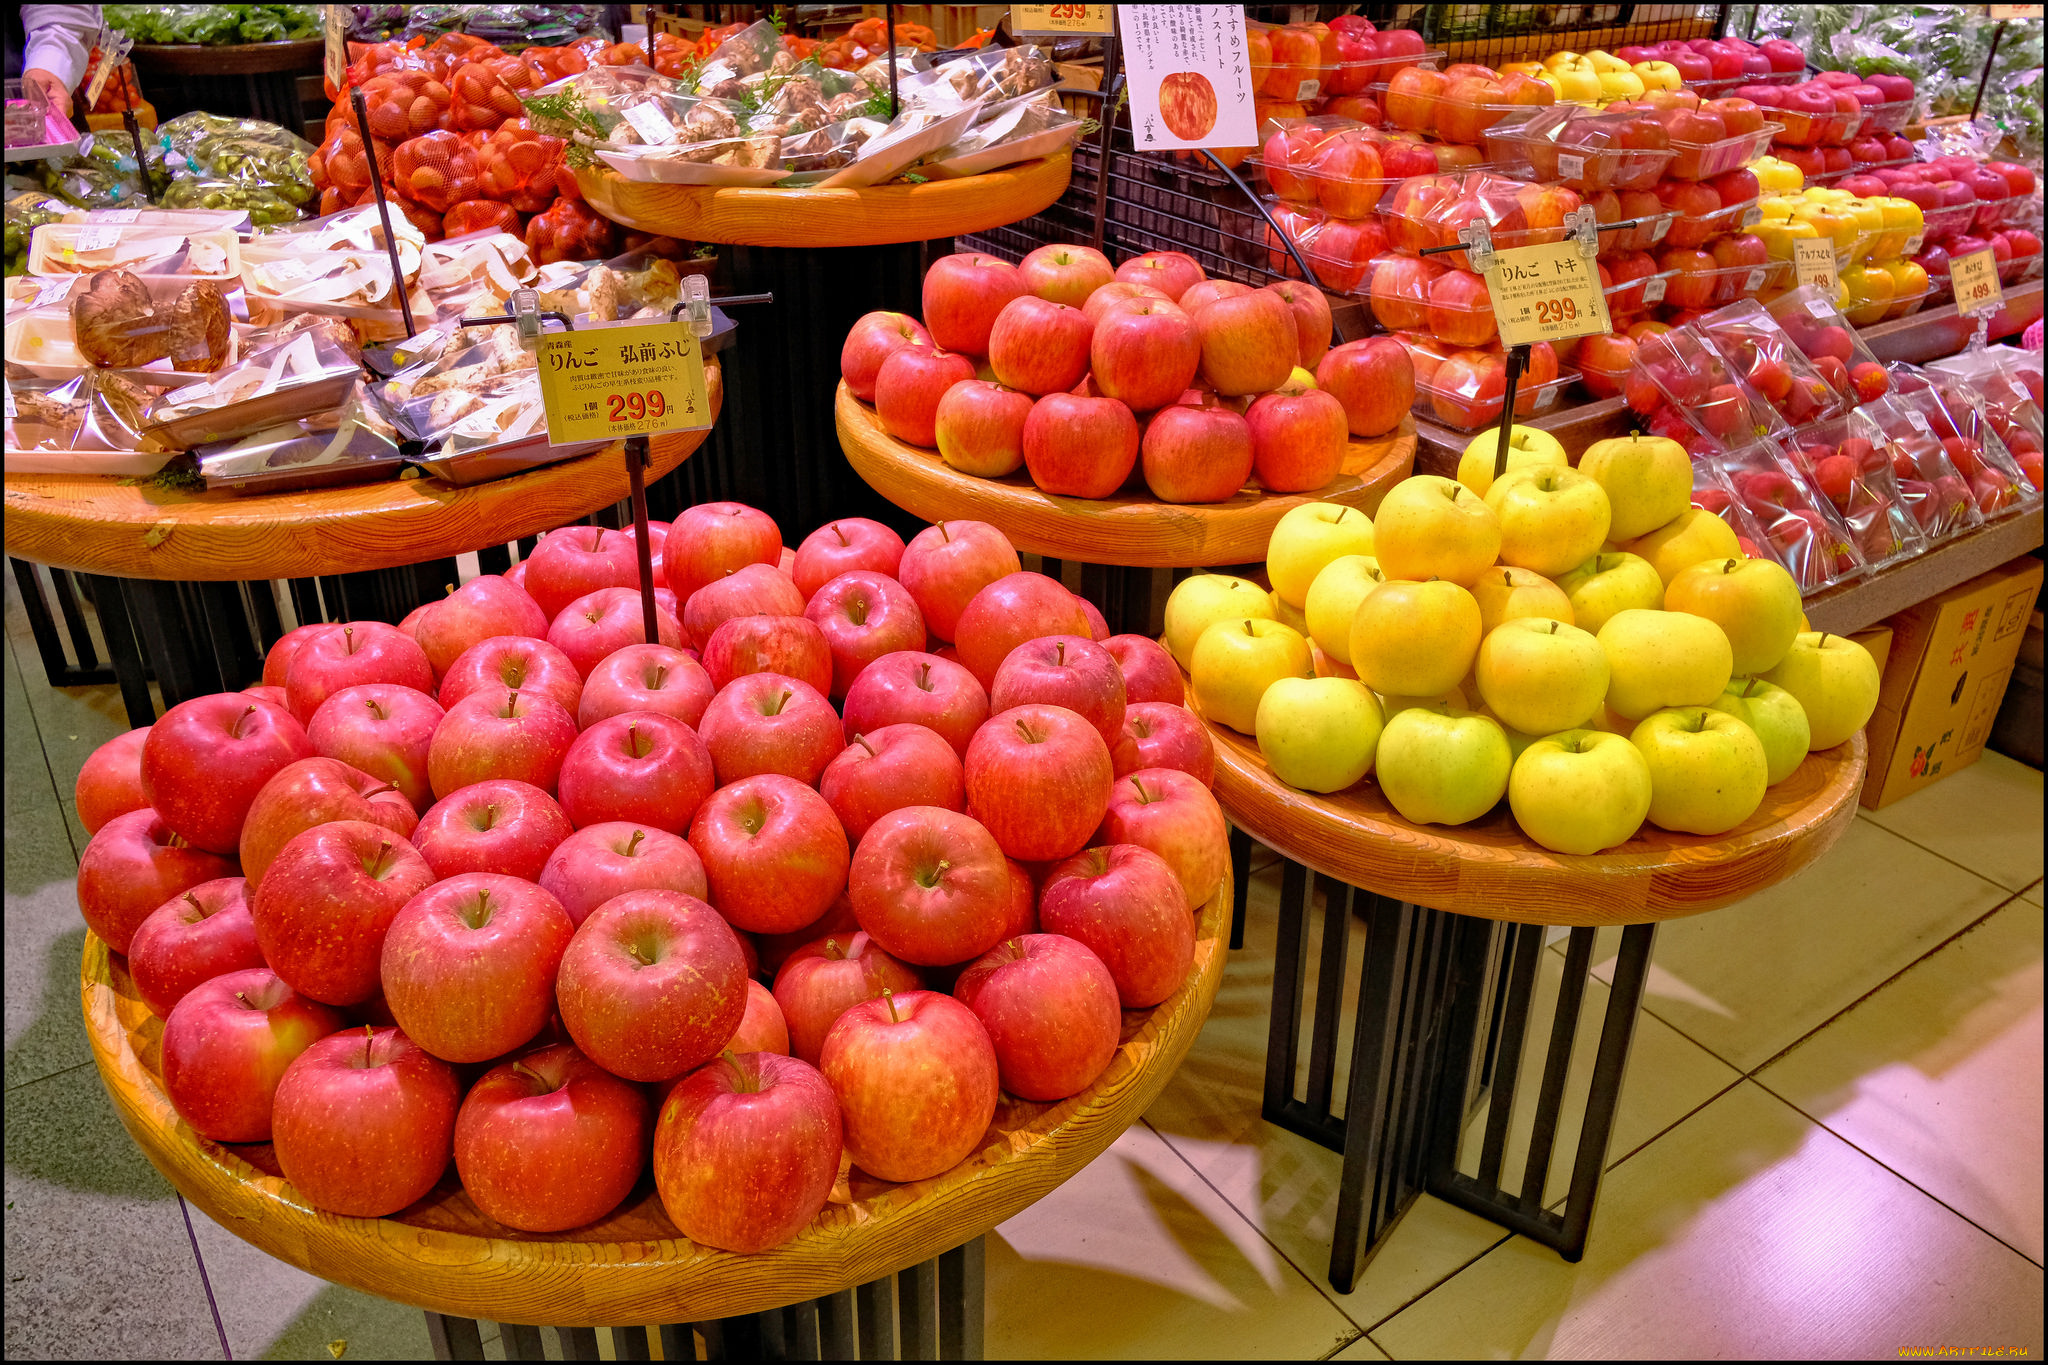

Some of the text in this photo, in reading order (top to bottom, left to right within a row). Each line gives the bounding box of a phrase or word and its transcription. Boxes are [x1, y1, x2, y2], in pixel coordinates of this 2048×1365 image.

[1142, 4, 1155, 70] 、長野県オリジナル
[1502, 258, 1577, 281] りんご トキ
[1972, 282, 1989, 299] 499
[550, 338, 691, 372] りんご 弘前ふじ
[583, 401, 598, 411] 1個
[563, 411, 600, 423] (税込価格)
